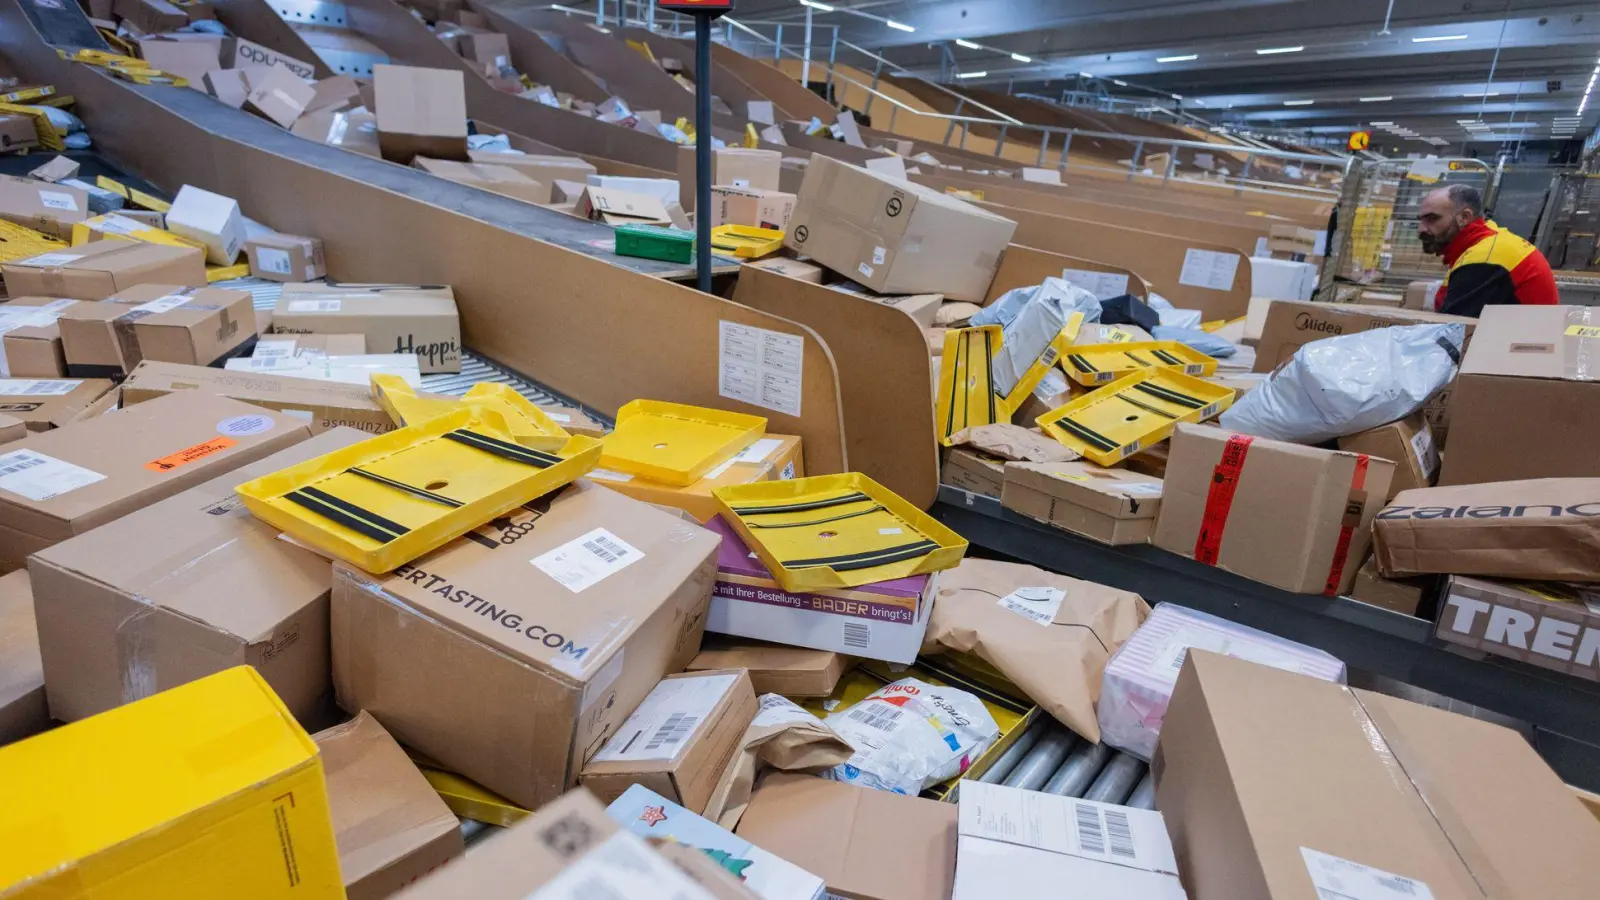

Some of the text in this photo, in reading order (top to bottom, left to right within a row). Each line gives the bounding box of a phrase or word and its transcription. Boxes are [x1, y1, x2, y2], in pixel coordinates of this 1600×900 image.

[1299, 313, 1342, 335] Midea
[394, 334, 461, 366] Happi
[720, 586, 735, 596] mit
[736, 587, 756, 599] Ihrer
[757, 590, 802, 607] Bestellung
[812, 597, 869, 615] BADER
